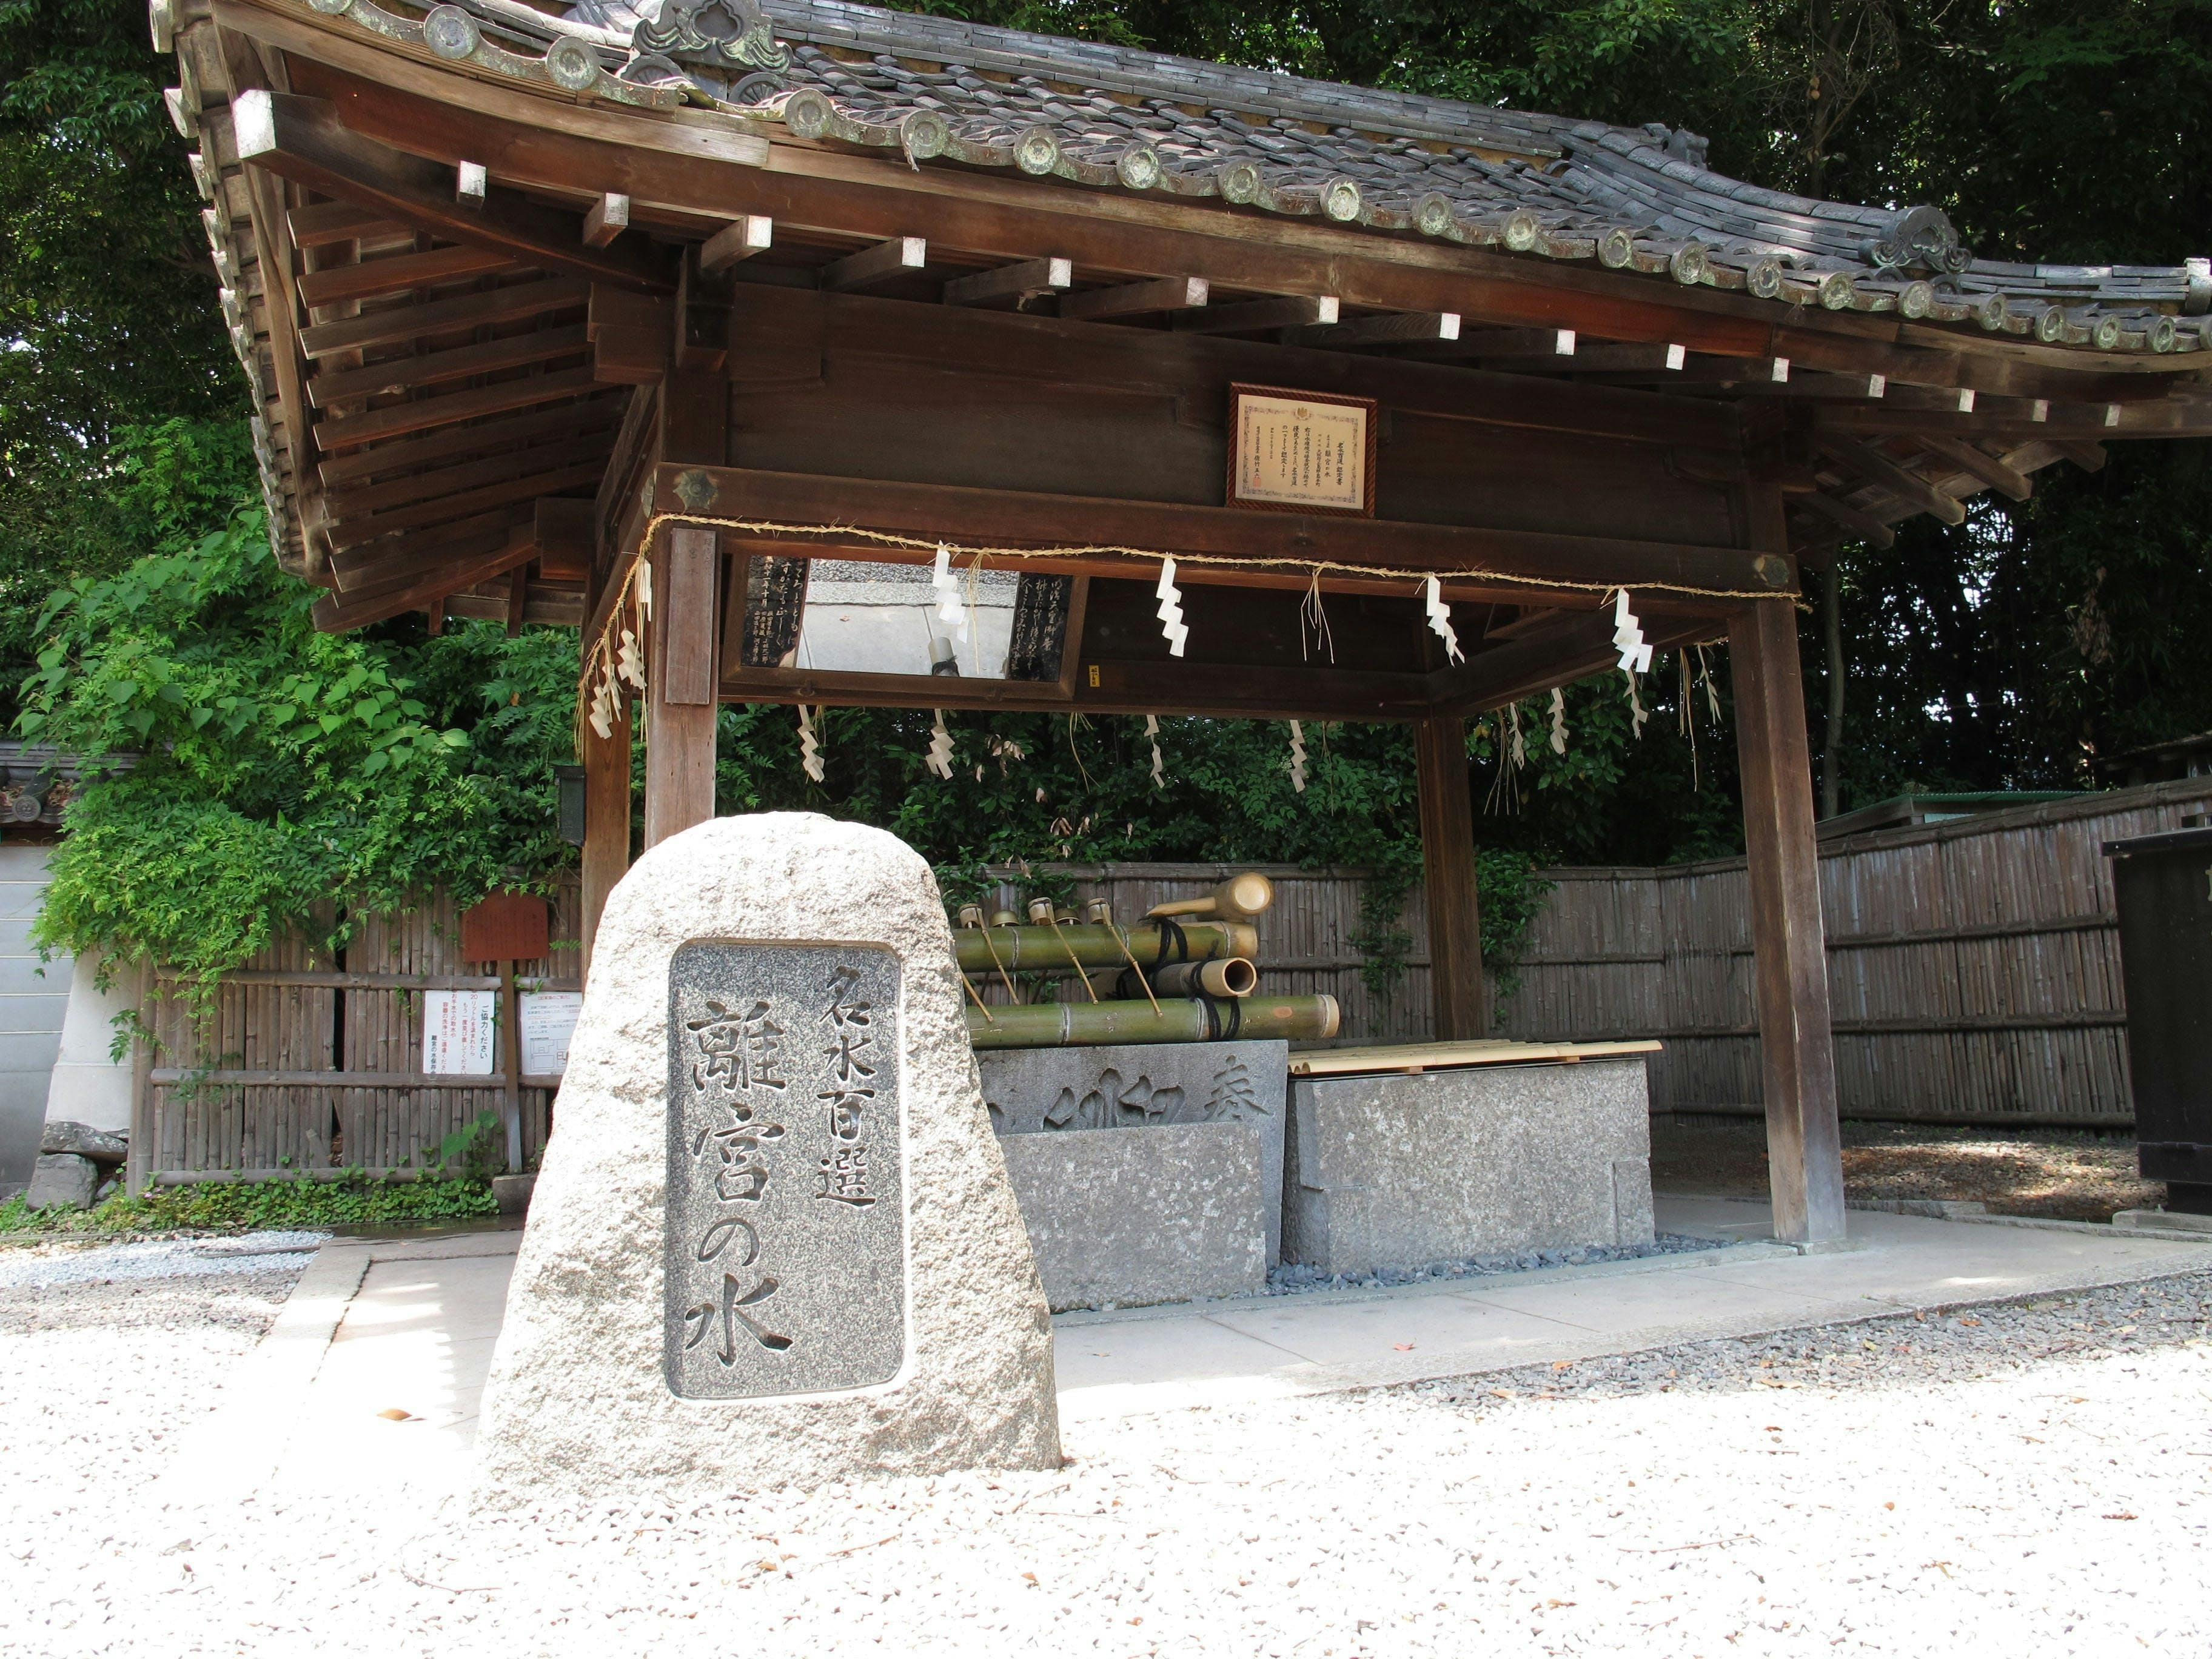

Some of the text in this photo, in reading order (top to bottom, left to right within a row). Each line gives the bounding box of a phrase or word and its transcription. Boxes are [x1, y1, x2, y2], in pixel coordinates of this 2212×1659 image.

[480, 1005, 489, 1059] ご協力ください
[815, 965, 879, 1207] 名水百選
[685, 1000, 794, 1369] 離宮の水
